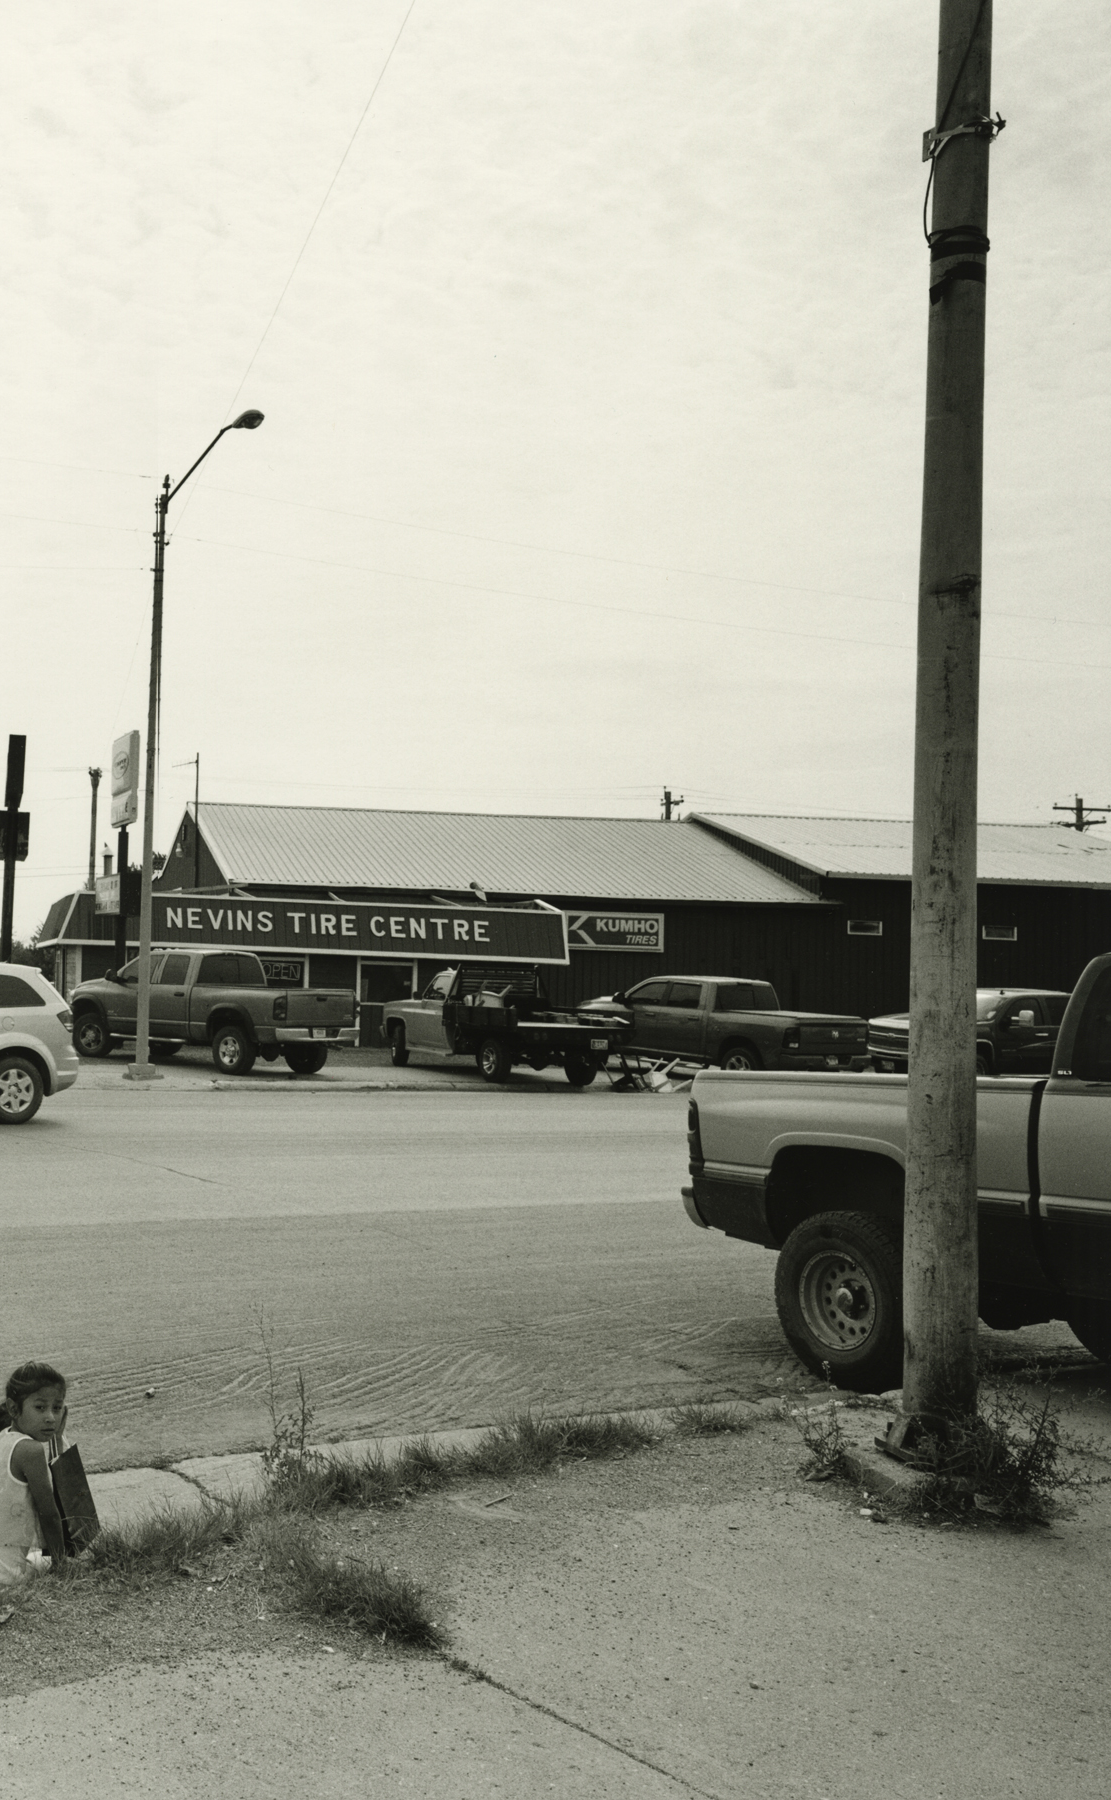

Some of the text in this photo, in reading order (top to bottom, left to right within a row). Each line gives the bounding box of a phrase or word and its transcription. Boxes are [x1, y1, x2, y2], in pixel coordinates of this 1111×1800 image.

[166, 907, 490, 942] NEVINS TIRE CENTRE
[596, 918, 658, 933] KUMHO
[626, 935, 657, 945] TIRES
[263, 963, 299, 979] OPEN
